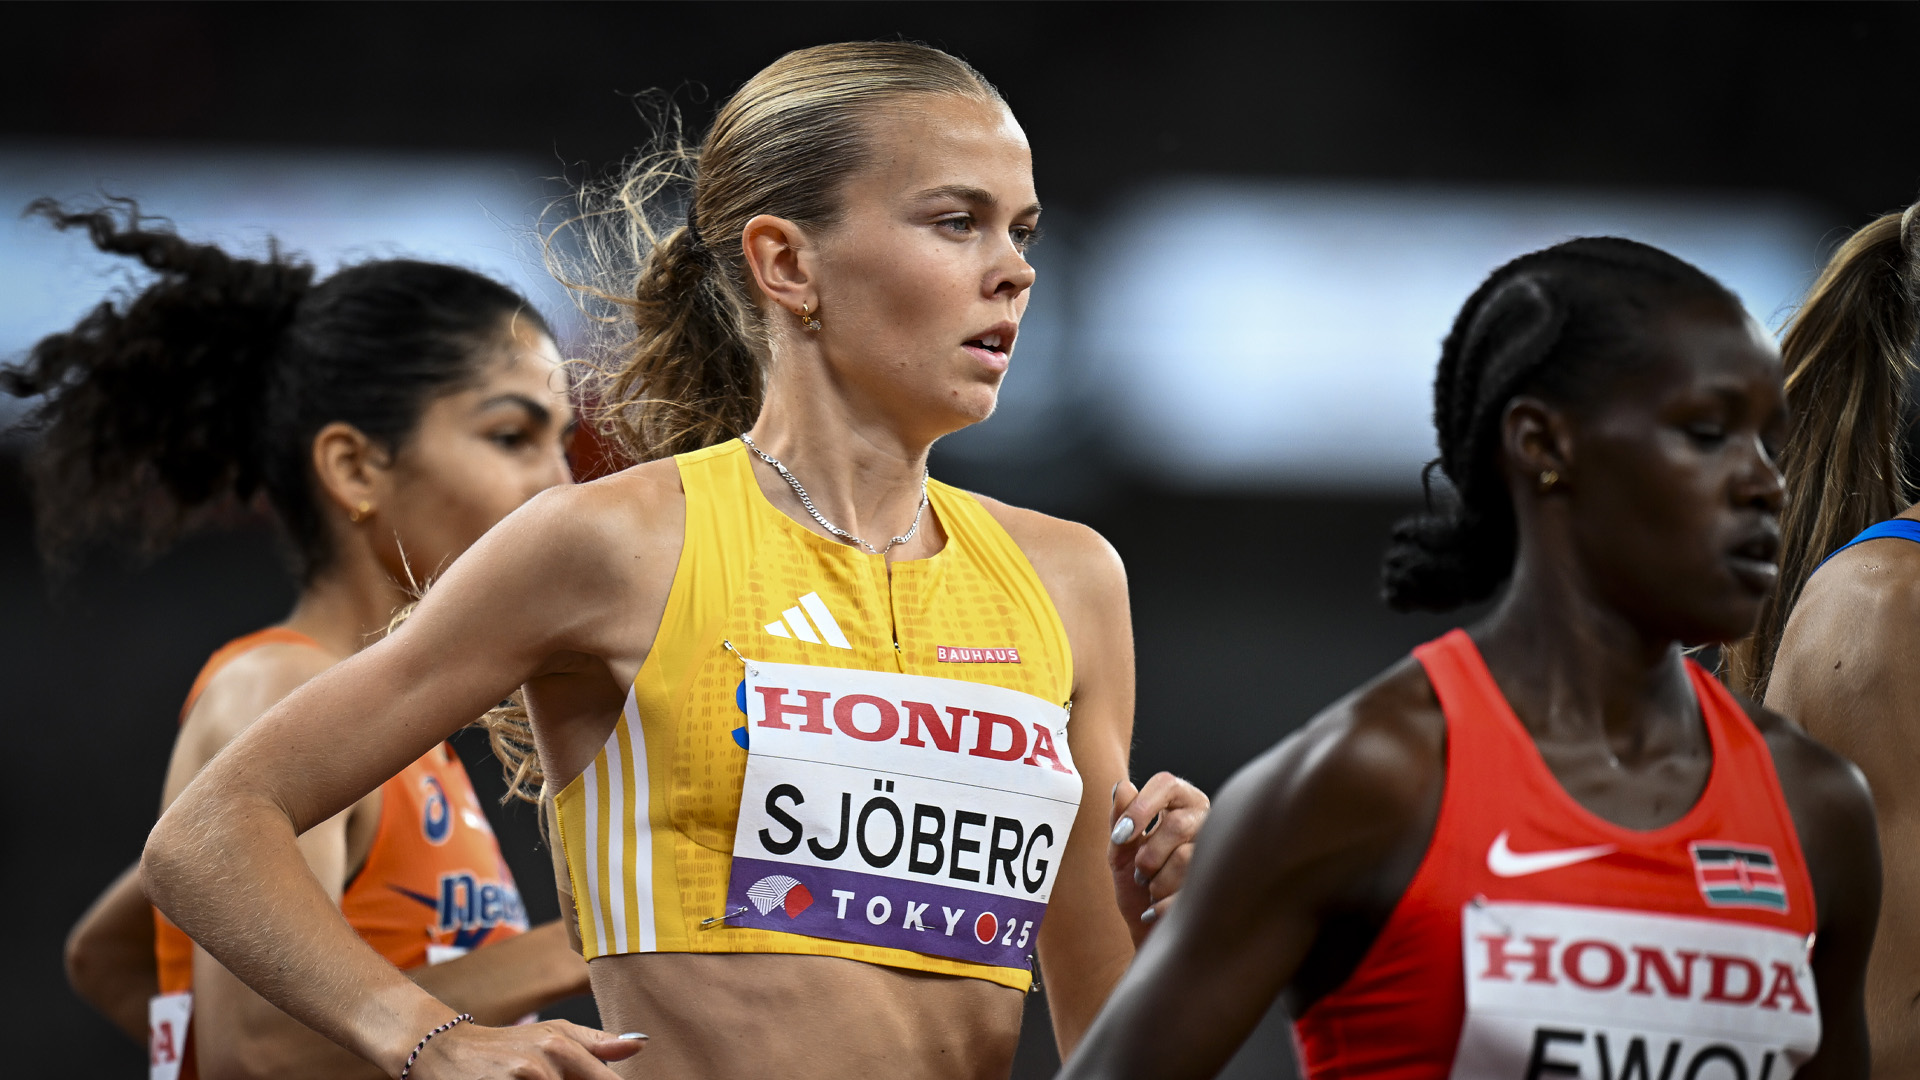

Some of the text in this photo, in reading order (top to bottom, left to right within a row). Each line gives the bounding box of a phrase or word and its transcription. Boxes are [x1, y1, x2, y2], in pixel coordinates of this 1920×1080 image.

[938, 647, 1019, 661] BAUHAUS
[754, 685, 1073, 775] HONDA
[758, 778, 1055, 894] SJÖBERG
[1477, 933, 1813, 1014] HONDA
